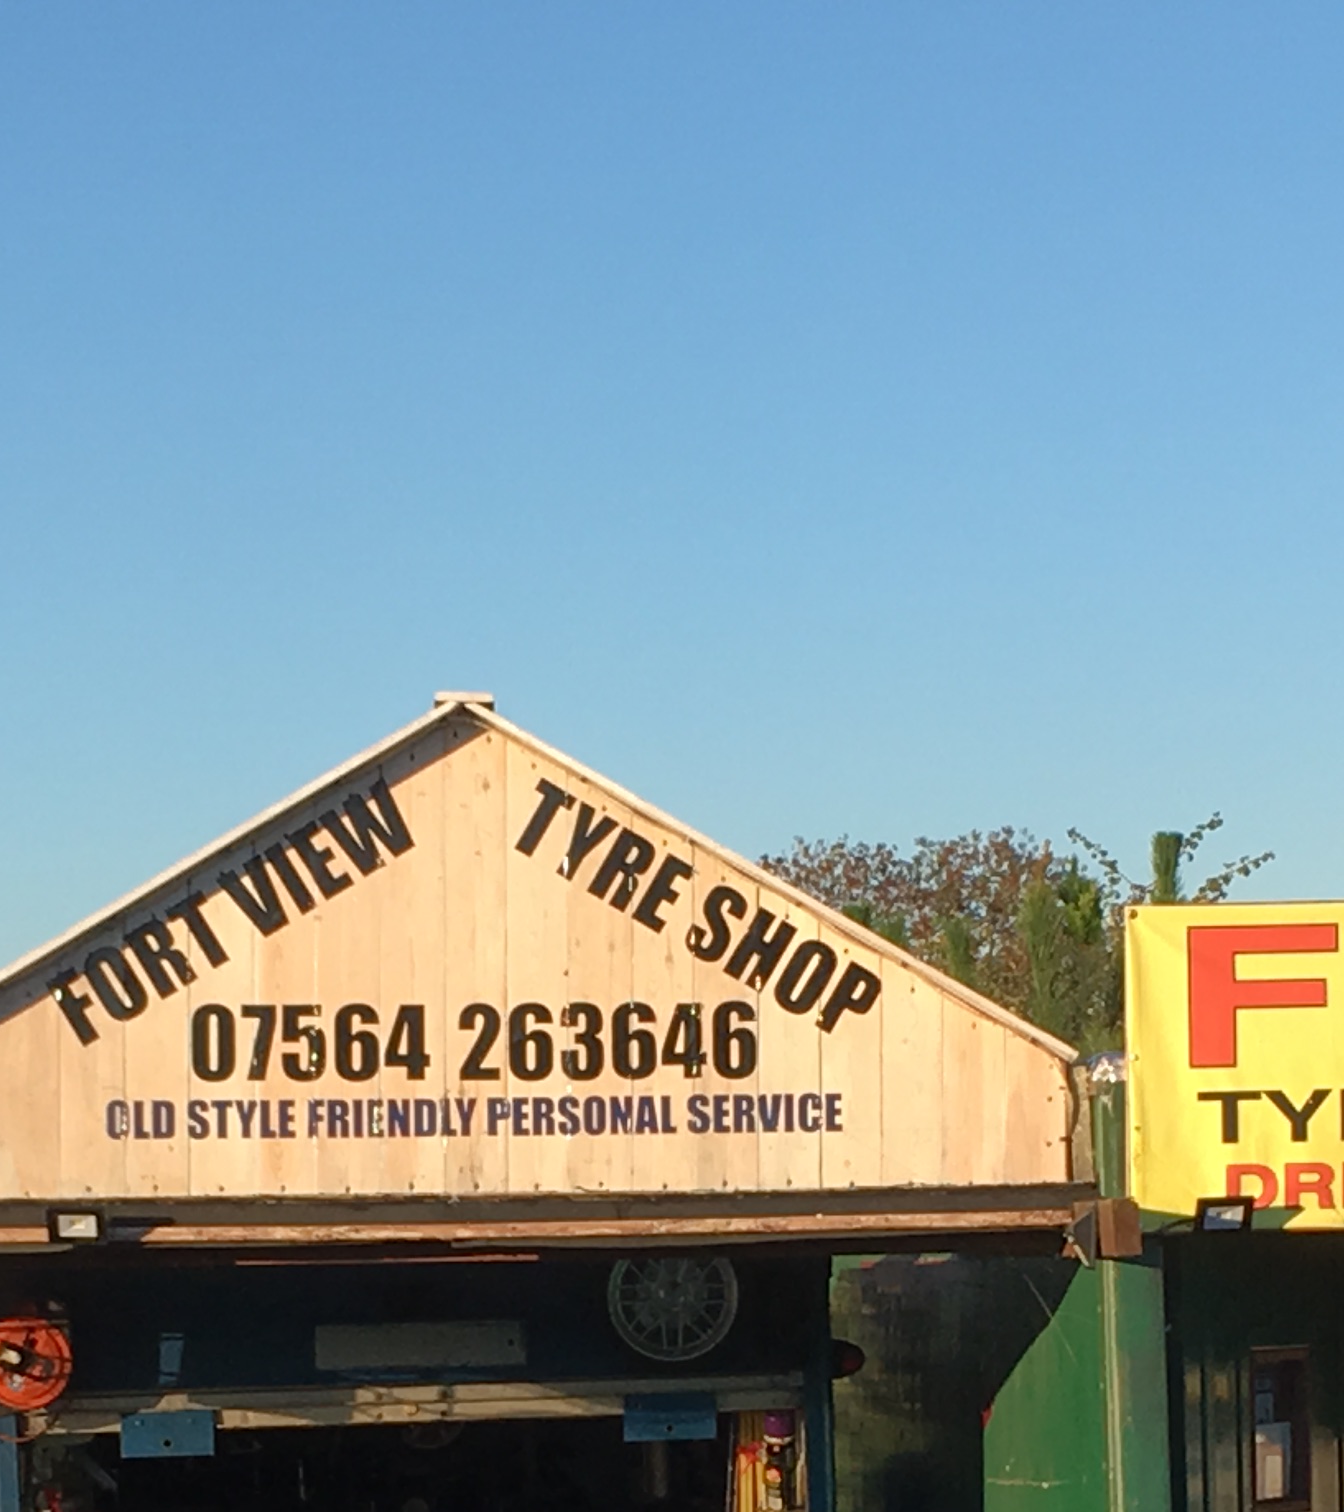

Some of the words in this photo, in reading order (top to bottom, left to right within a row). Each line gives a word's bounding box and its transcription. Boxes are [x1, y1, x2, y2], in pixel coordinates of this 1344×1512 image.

[46, 889, 230, 1047] FORT
[217, 777, 416, 938] VIEW
[514, 778, 695, 934] TYRE
[685, 885, 882, 1034] SHOP
[106, 1099, 176, 1140] OLD
[187, 1099, 297, 1139] STYLE
[307, 1097, 478, 1139] FRIENDLY
[486, 1095, 677, 1137] PERSONAL
[687, 1092, 844, 1134] SERVICE
[191, 1003, 431, 1083] 07564
[458, 1001, 758, 1082] 263646
